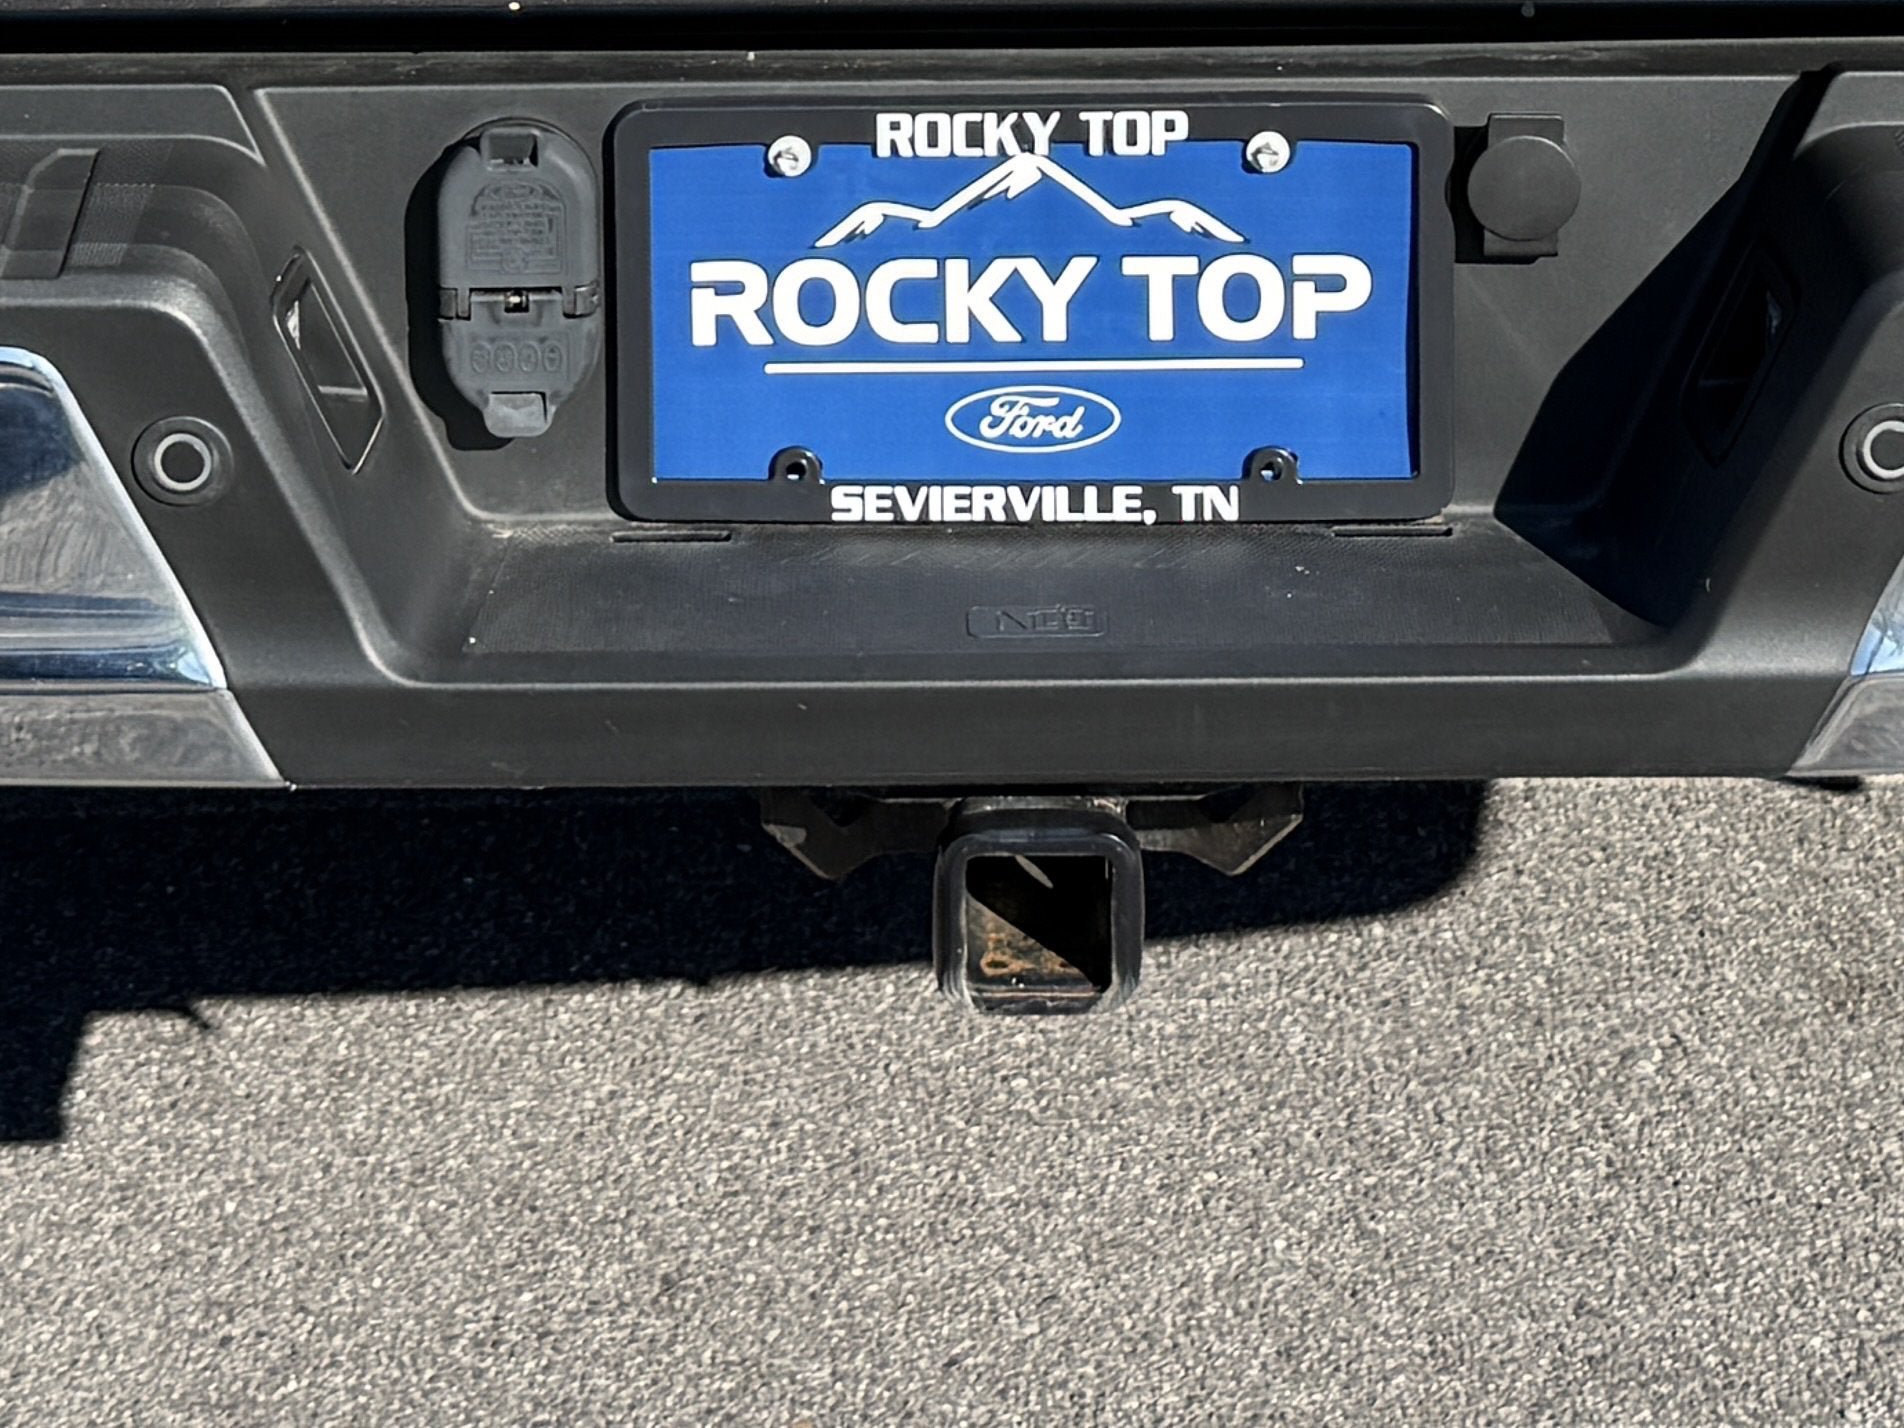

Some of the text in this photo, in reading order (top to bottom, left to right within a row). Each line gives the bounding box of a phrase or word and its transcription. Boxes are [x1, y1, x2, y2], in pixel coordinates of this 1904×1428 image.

[875, 110, 1189, 158] ROCKY TOP
[690, 252, 1373, 346] ROCKY TOP
[979, 394, 1086, 439] Ford
[830, 484, 1239, 525] SEVIERVILLE, TN
